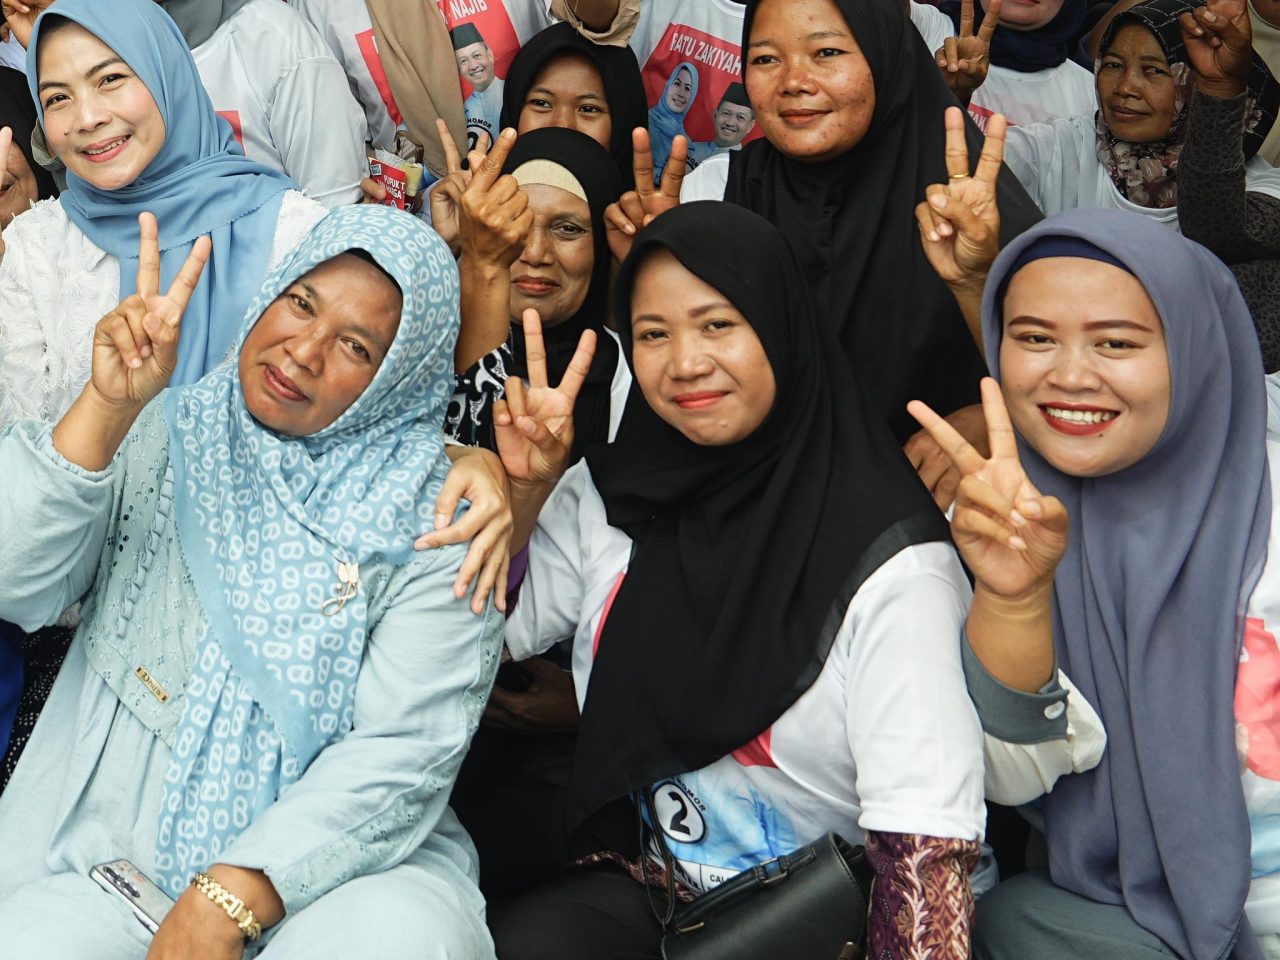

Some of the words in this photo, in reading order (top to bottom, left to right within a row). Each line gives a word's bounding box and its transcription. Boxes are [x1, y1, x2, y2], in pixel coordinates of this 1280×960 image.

[670, 32, 696, 57] RATU
[694, 41, 742, 77] ZAKIYAH
[667, 790, 691, 837] 2
